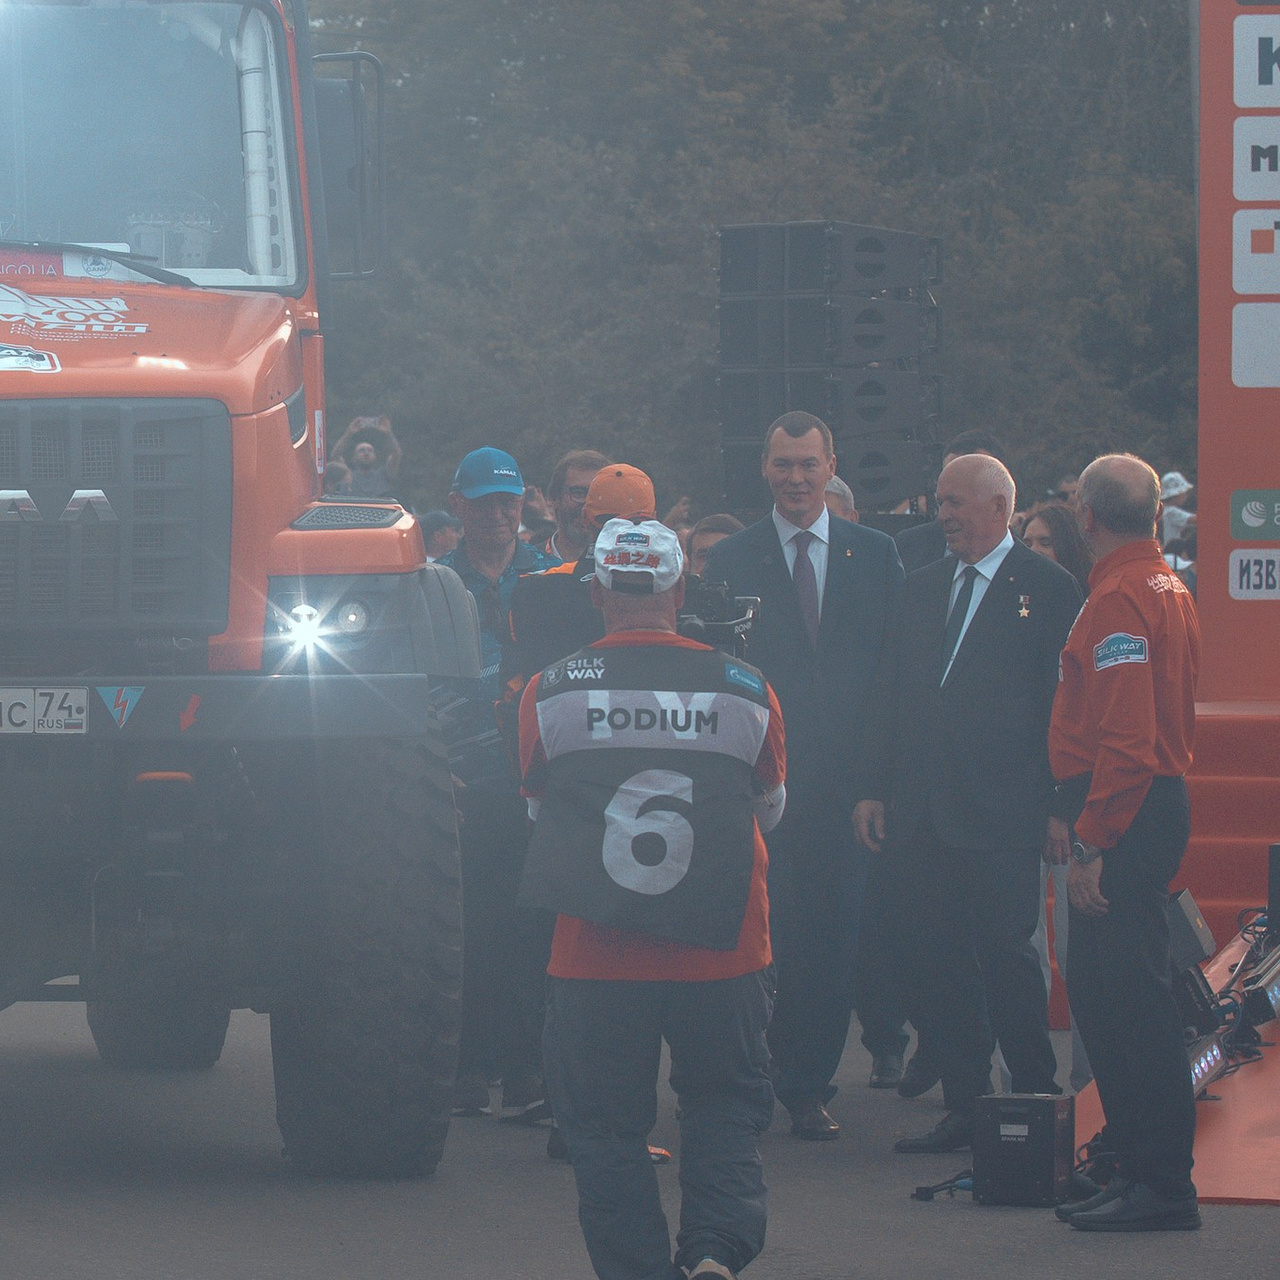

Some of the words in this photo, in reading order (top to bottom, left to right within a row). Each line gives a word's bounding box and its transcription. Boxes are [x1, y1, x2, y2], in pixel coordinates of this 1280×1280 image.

[1097, 645, 1119, 658] SILK
[1120, 642, 1142, 651] WAY
[566, 657, 606, 670] SILK
[566, 669, 606, 680] WAY
[37, 718, 64, 730] RUS
[586, 707, 720, 735] PODIUM
[602, 769, 695, 896] 6
